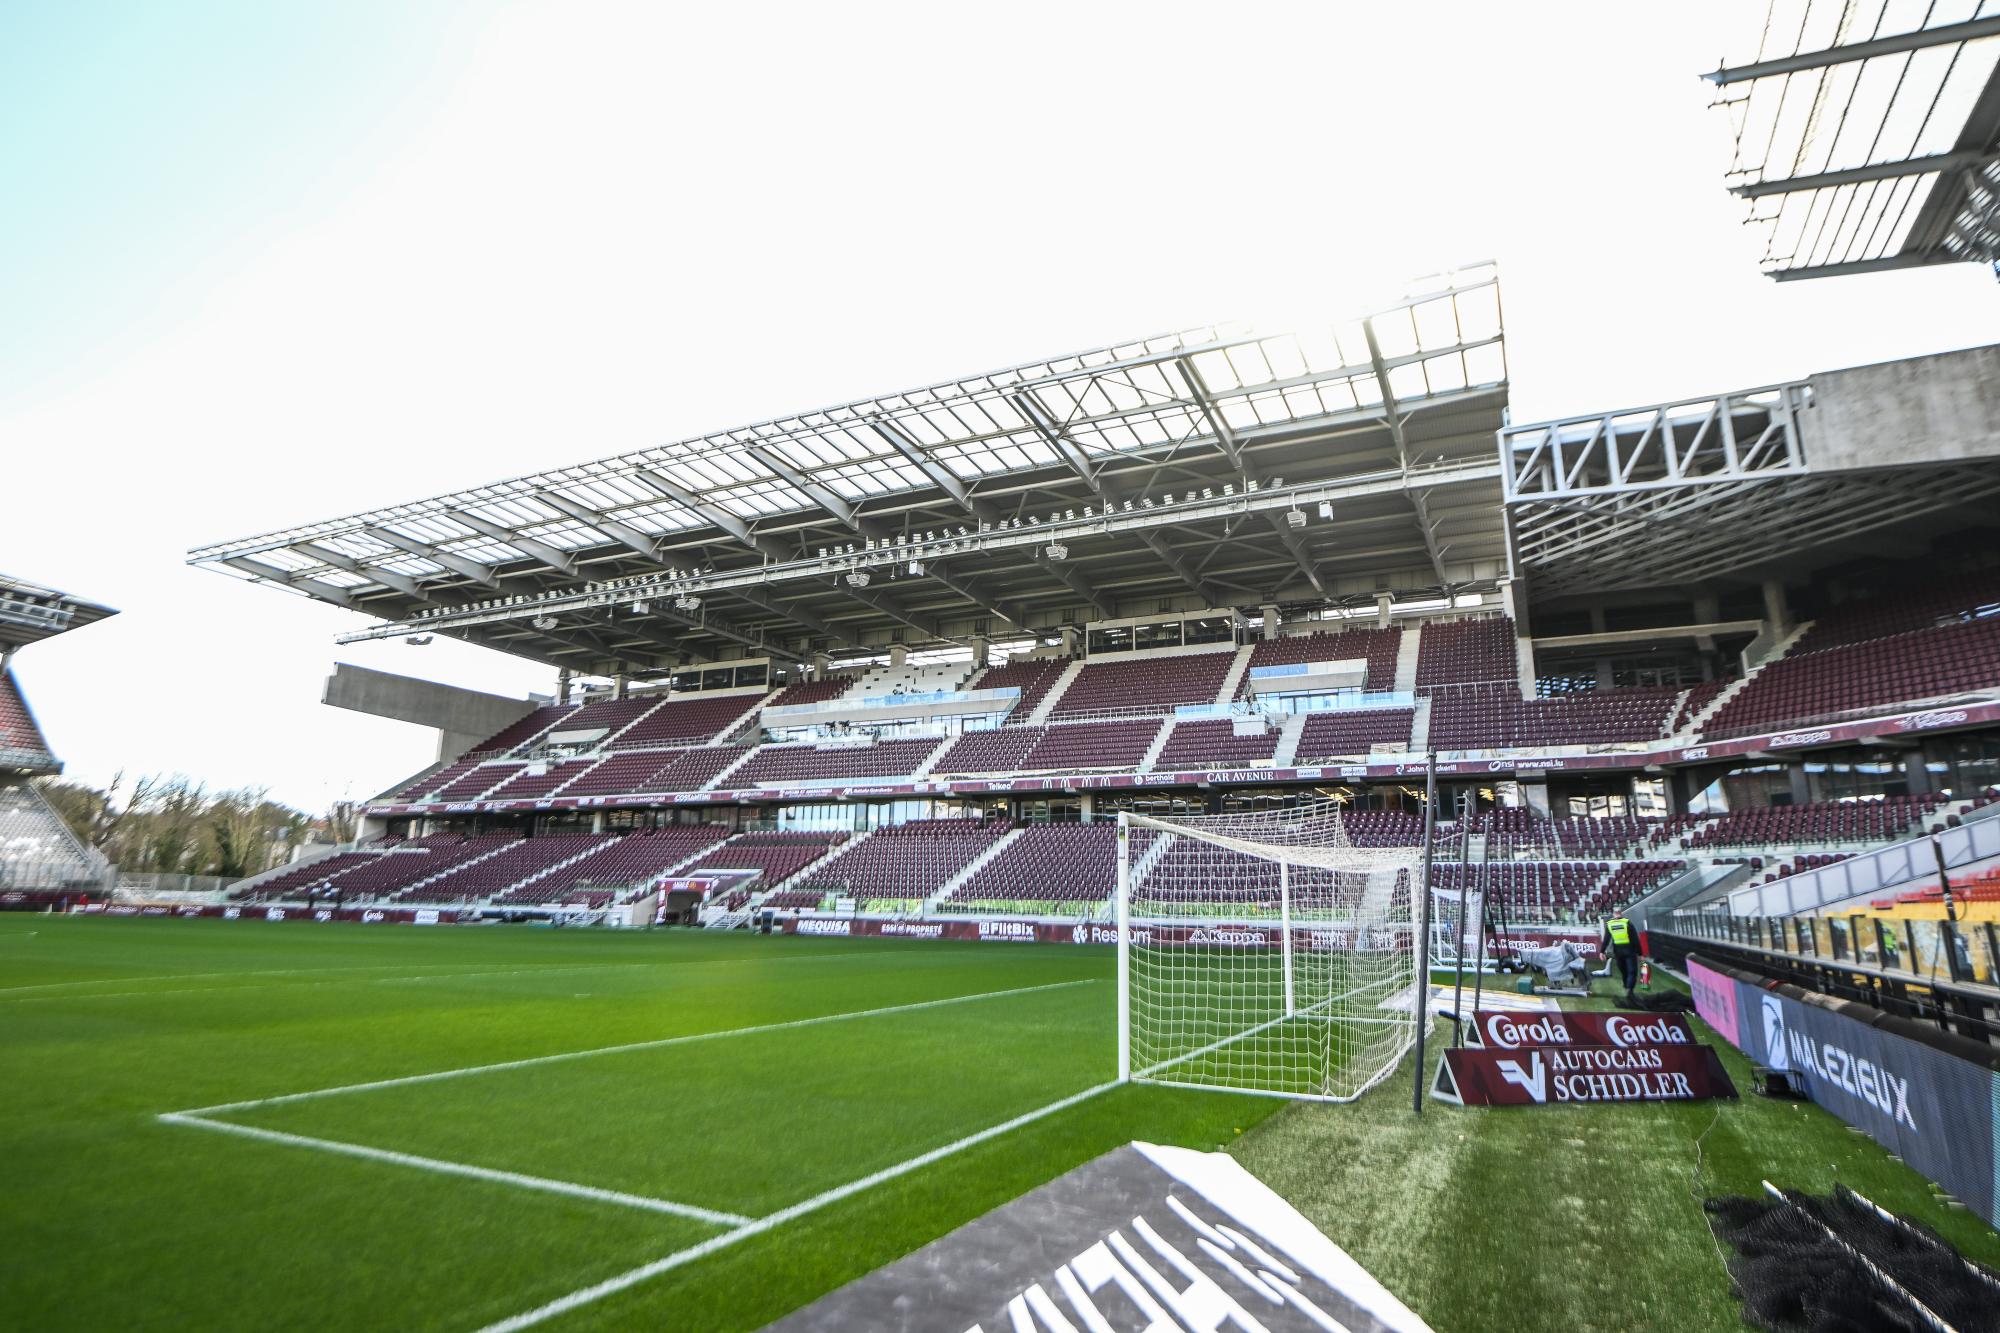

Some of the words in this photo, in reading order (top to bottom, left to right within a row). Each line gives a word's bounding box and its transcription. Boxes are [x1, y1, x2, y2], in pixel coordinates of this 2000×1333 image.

[1206, 772, 1230, 783] CAR
[1232, 771, 1274, 782] AVENUE
[1407, 765, 1424, 773] John
[1426, 763, 1457, 772] Cckerill
[1145, 773, 1175, 782] berthold
[796, 919, 850, 934] MEQUISA
[1209, 928, 1265, 946] Kappa
[1486, 1014, 1571, 1050] Carola
[1605, 1015, 1686, 1048] Carola
[1551, 1048, 1663, 1071] AUTOCARS
[1553, 1071, 1696, 1102] SCHIDLER
[1788, 1027, 1918, 1133] MALEZIEUX
